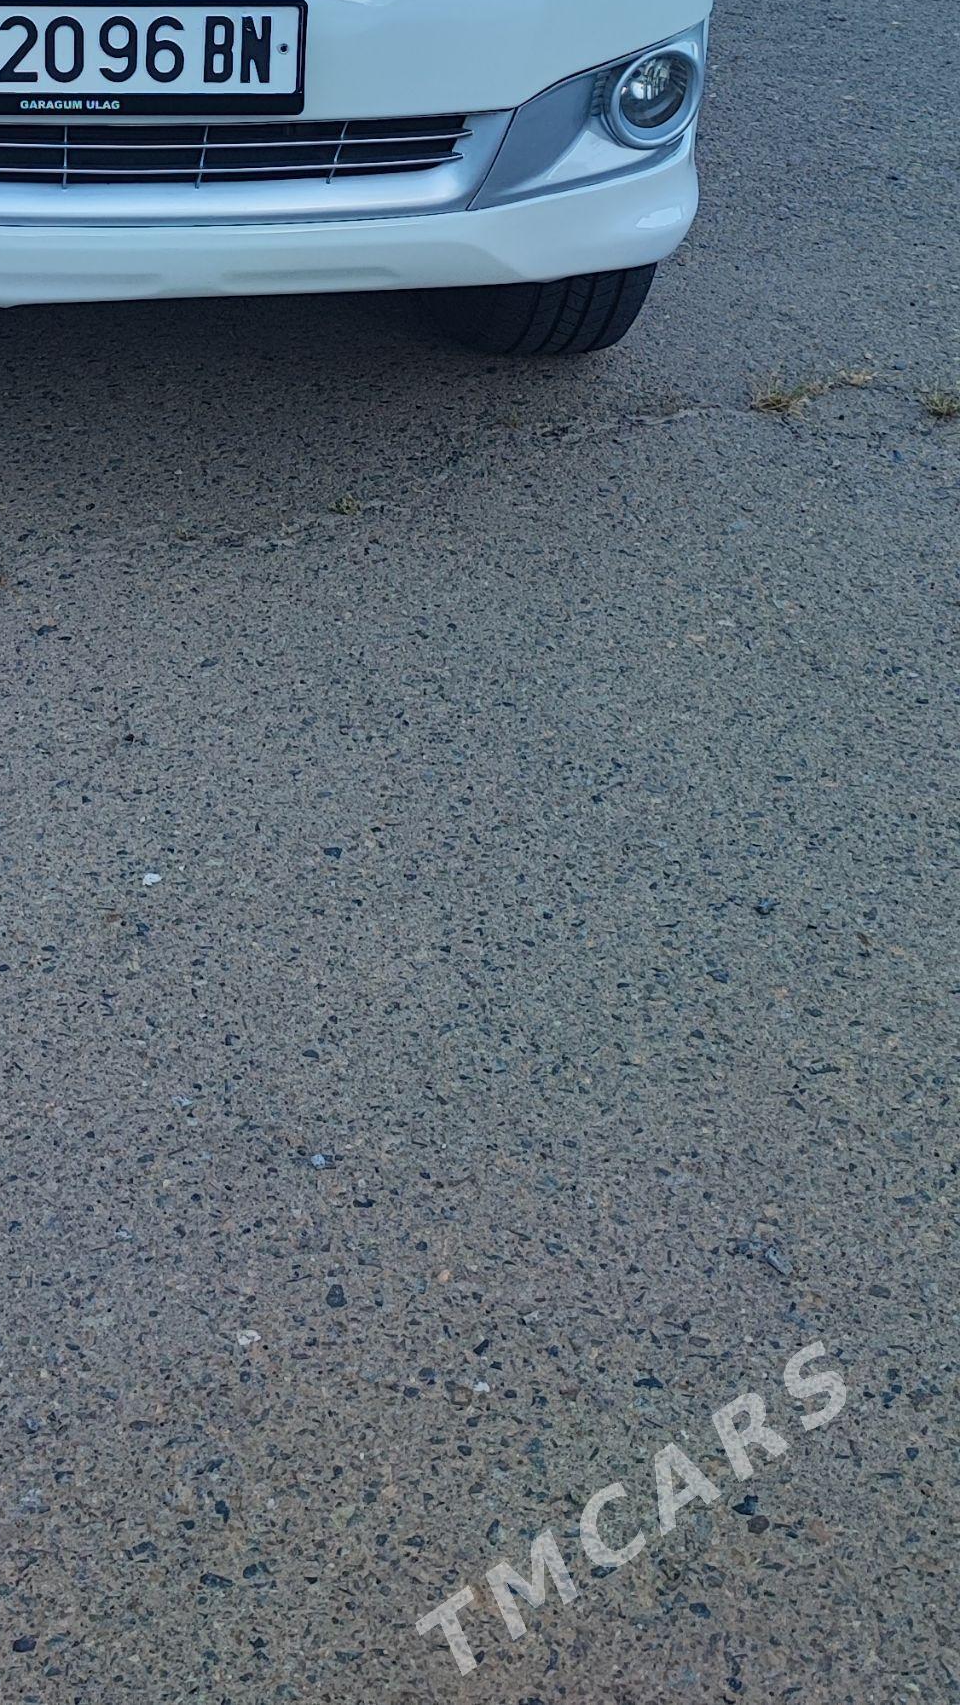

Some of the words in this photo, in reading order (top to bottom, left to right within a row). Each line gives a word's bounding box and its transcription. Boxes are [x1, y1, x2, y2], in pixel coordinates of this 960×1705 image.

[203, 15, 271, 83] BN
[20, 99, 83, 110] GARAGUM
[86, 99, 121, 110] ULAG
